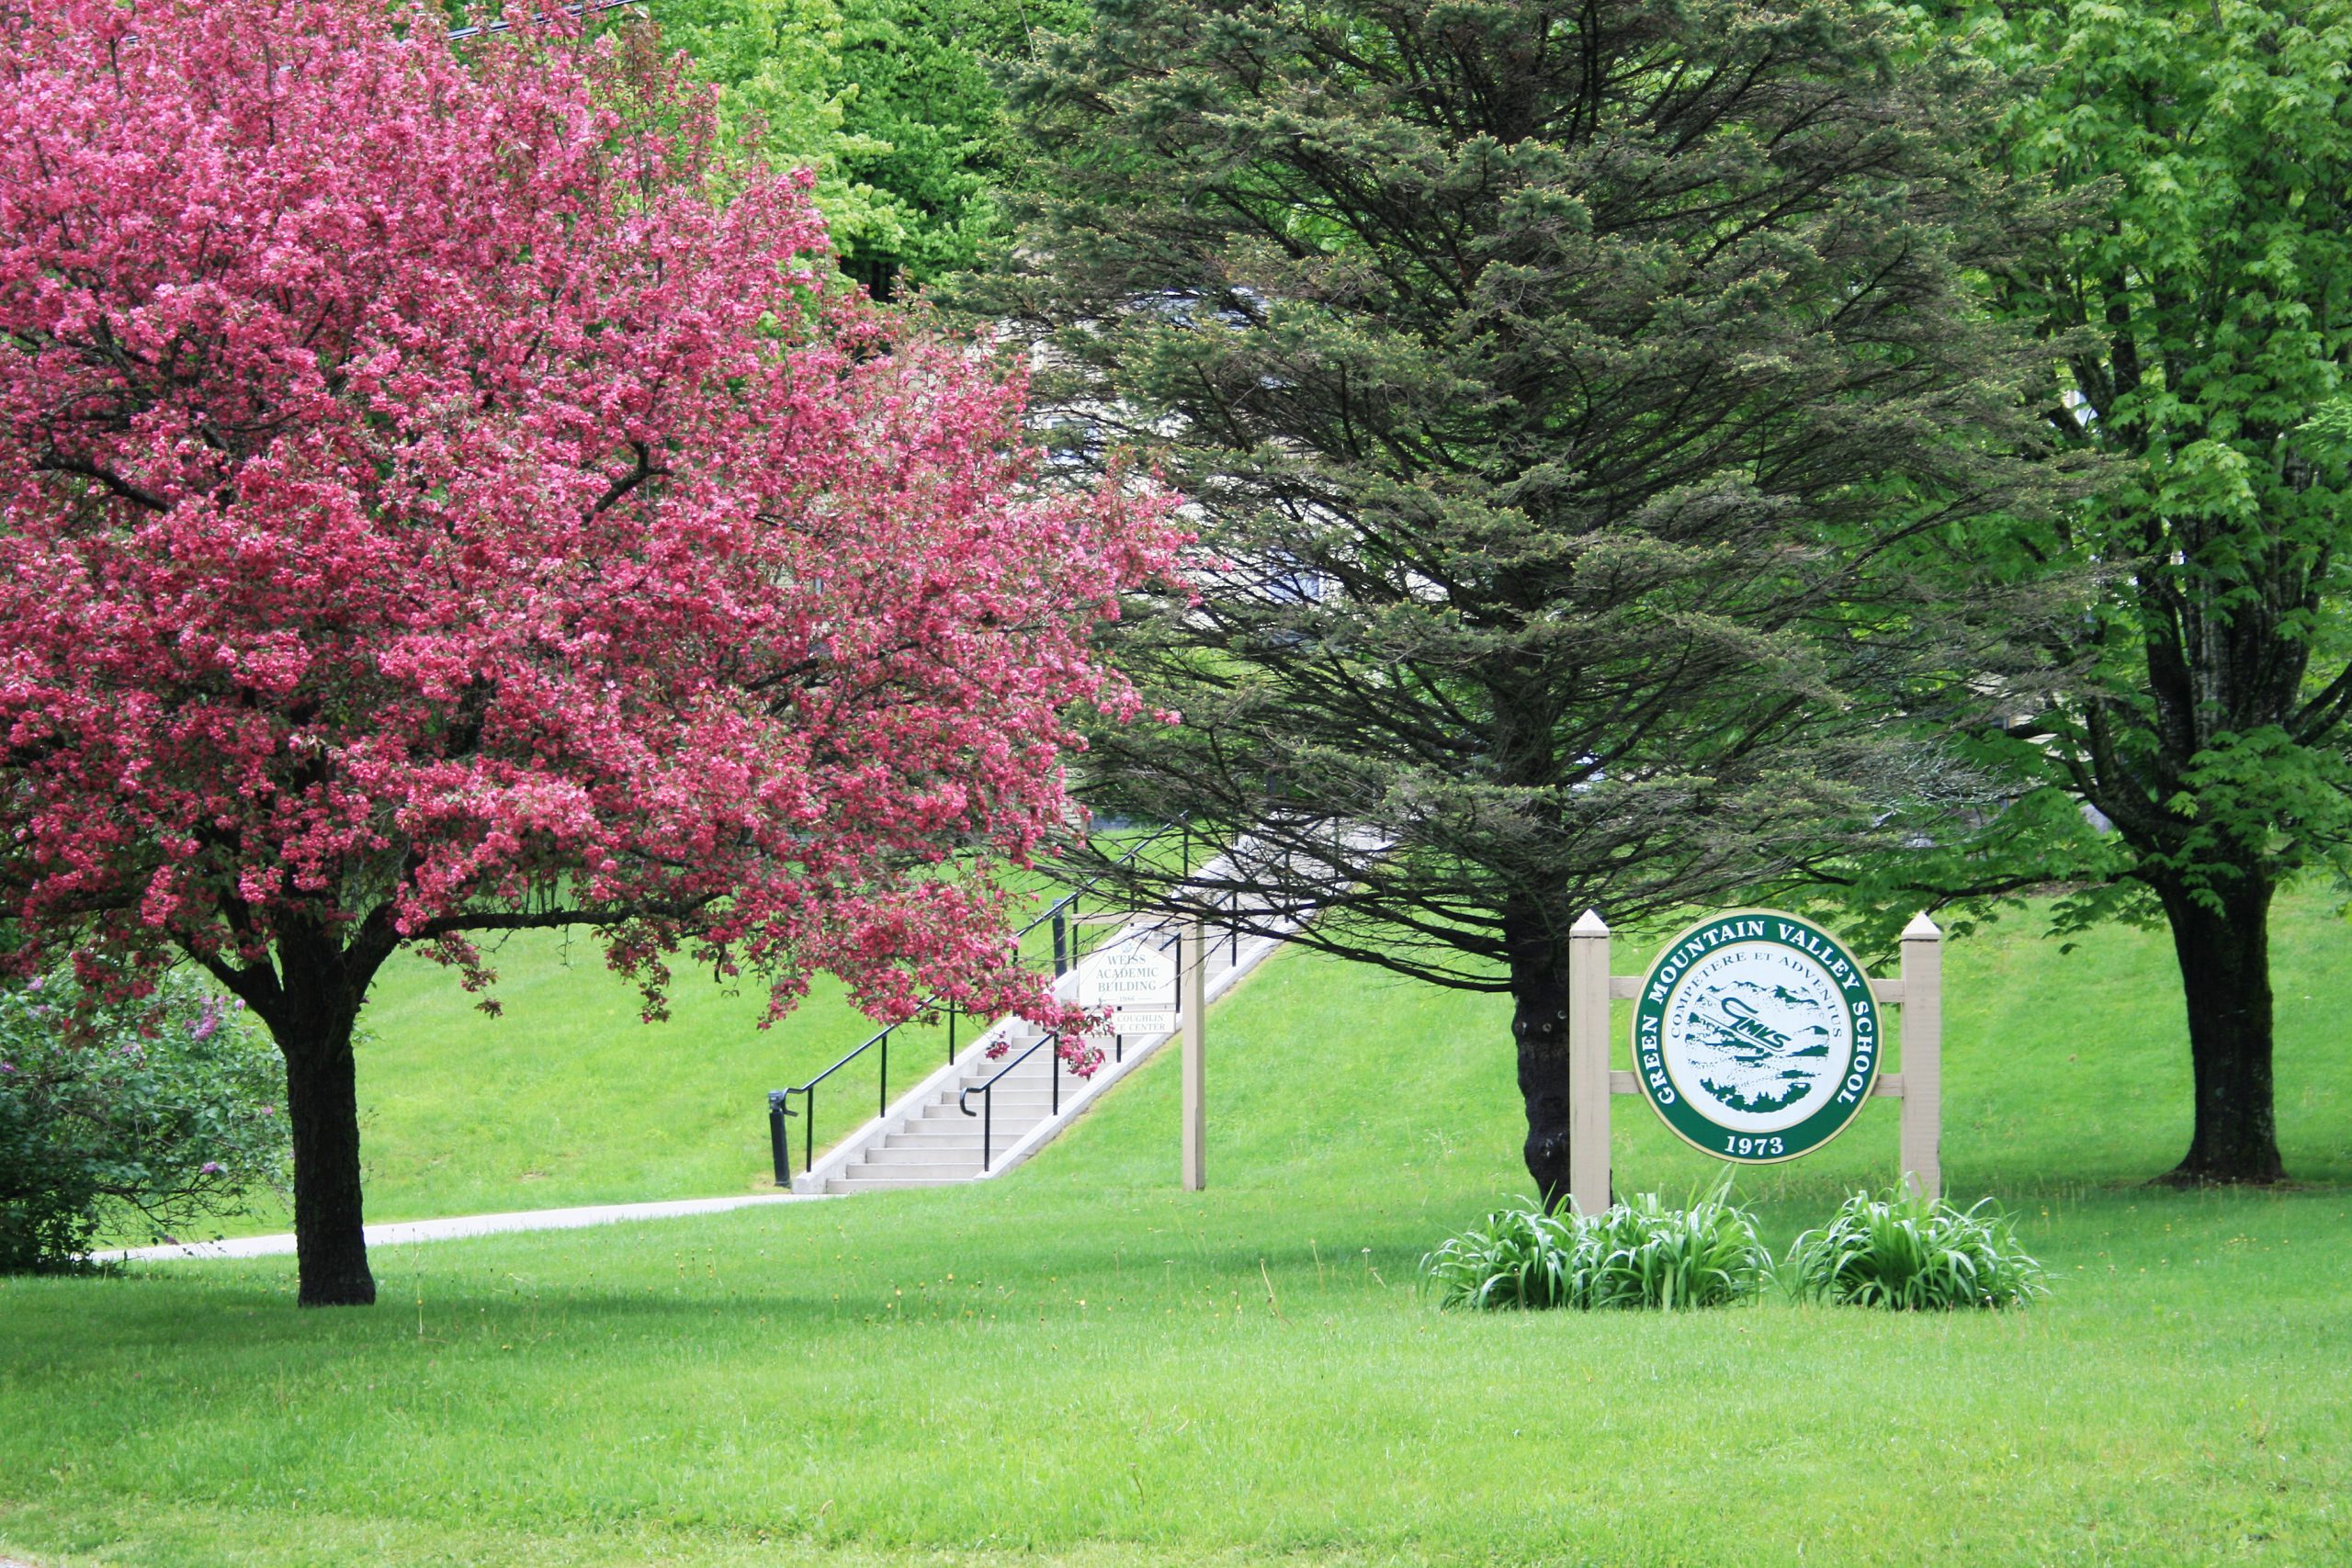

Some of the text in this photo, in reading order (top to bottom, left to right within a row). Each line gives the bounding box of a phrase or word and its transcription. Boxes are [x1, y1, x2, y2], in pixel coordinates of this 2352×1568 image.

[1107, 954, 1146, 965] WEISS
[1096, 967, 1159, 979] ACADEMIC
[1098, 980, 1157, 992] BUILDING
[1671, 952, 1842, 1038] COMPETERE ET ADVENTUS
[1117, 1014, 1164, 1022] COUGHLIN
[1641, 920, 1872, 1104] GREEN MOUNTAIN VALLEY SCHOOL
[1129, 1023, 1166, 1032] CENTER
[1724, 1135, 1784, 1156] 1973
